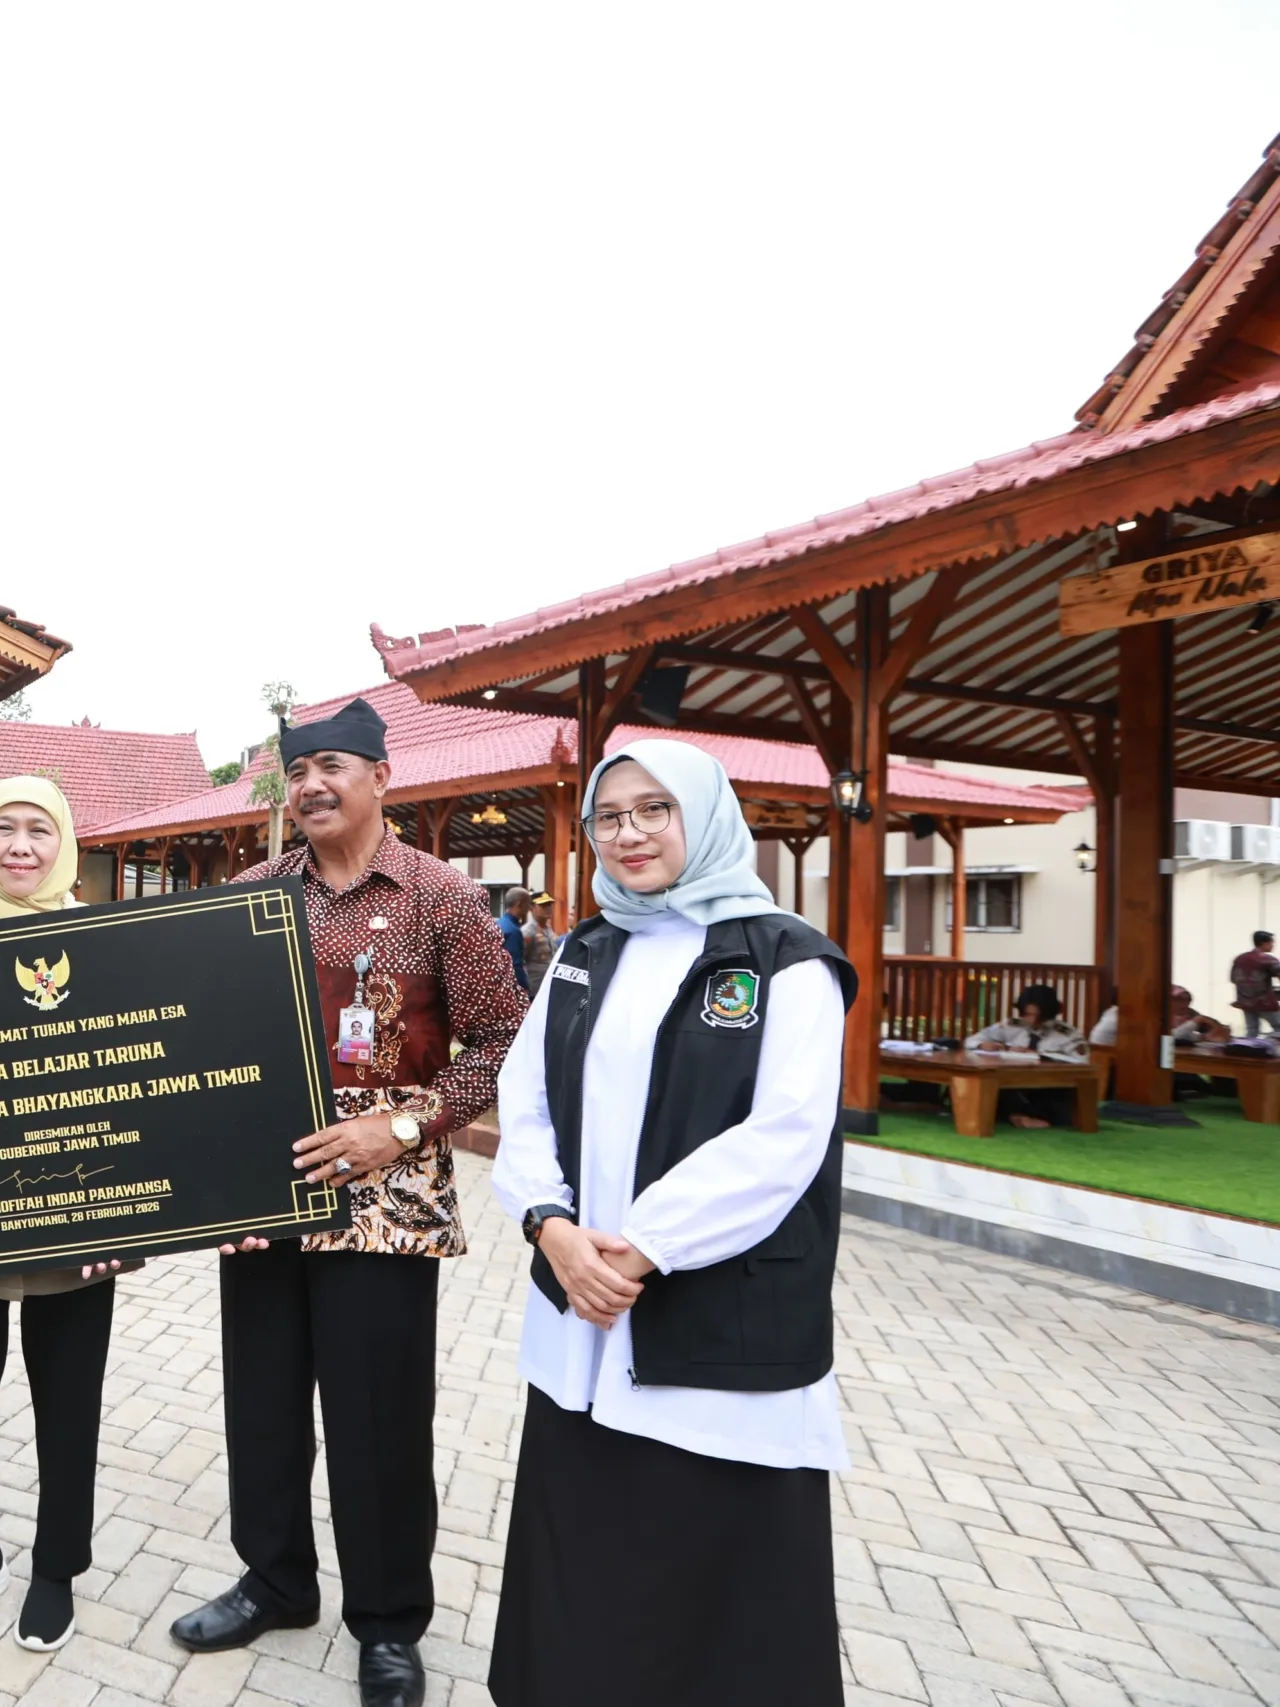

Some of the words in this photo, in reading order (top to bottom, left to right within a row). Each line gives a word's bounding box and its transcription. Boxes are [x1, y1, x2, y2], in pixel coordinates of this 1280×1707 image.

[1142, 545, 1248, 584] GRIYA
[30, 1020, 77, 1039] TUHAN
[77, 1014, 115, 1032] YANG
[116, 1008, 159, 1027] MAHA
[159, 1004, 187, 1020] ESA
[11, 1051, 91, 1079] BELAJAR
[92, 1041, 167, 1067] TARUNA
[11, 1081, 144, 1116] BHAYANGKARA
[146, 1073, 201, 1097] JAWA
[203, 1064, 262, 1089] TIMUR
[23, 1124, 85, 1142] DIRESMIKAN
[85, 1120, 111, 1134] OLEH
[62, 1135, 100, 1152] JAWA
[100, 1130, 141, 1147] TIMUR
[46, 1190, 87, 1207] INDAR
[88, 1178, 172, 1202] PARAWANSA
[0, 1213, 70, 1232] BANYUWANGI,
[70, 1211, 85, 1223] 28
[85, 1204, 134, 1221] FEBRUARI
[134, 1201, 160, 1214] 2026
